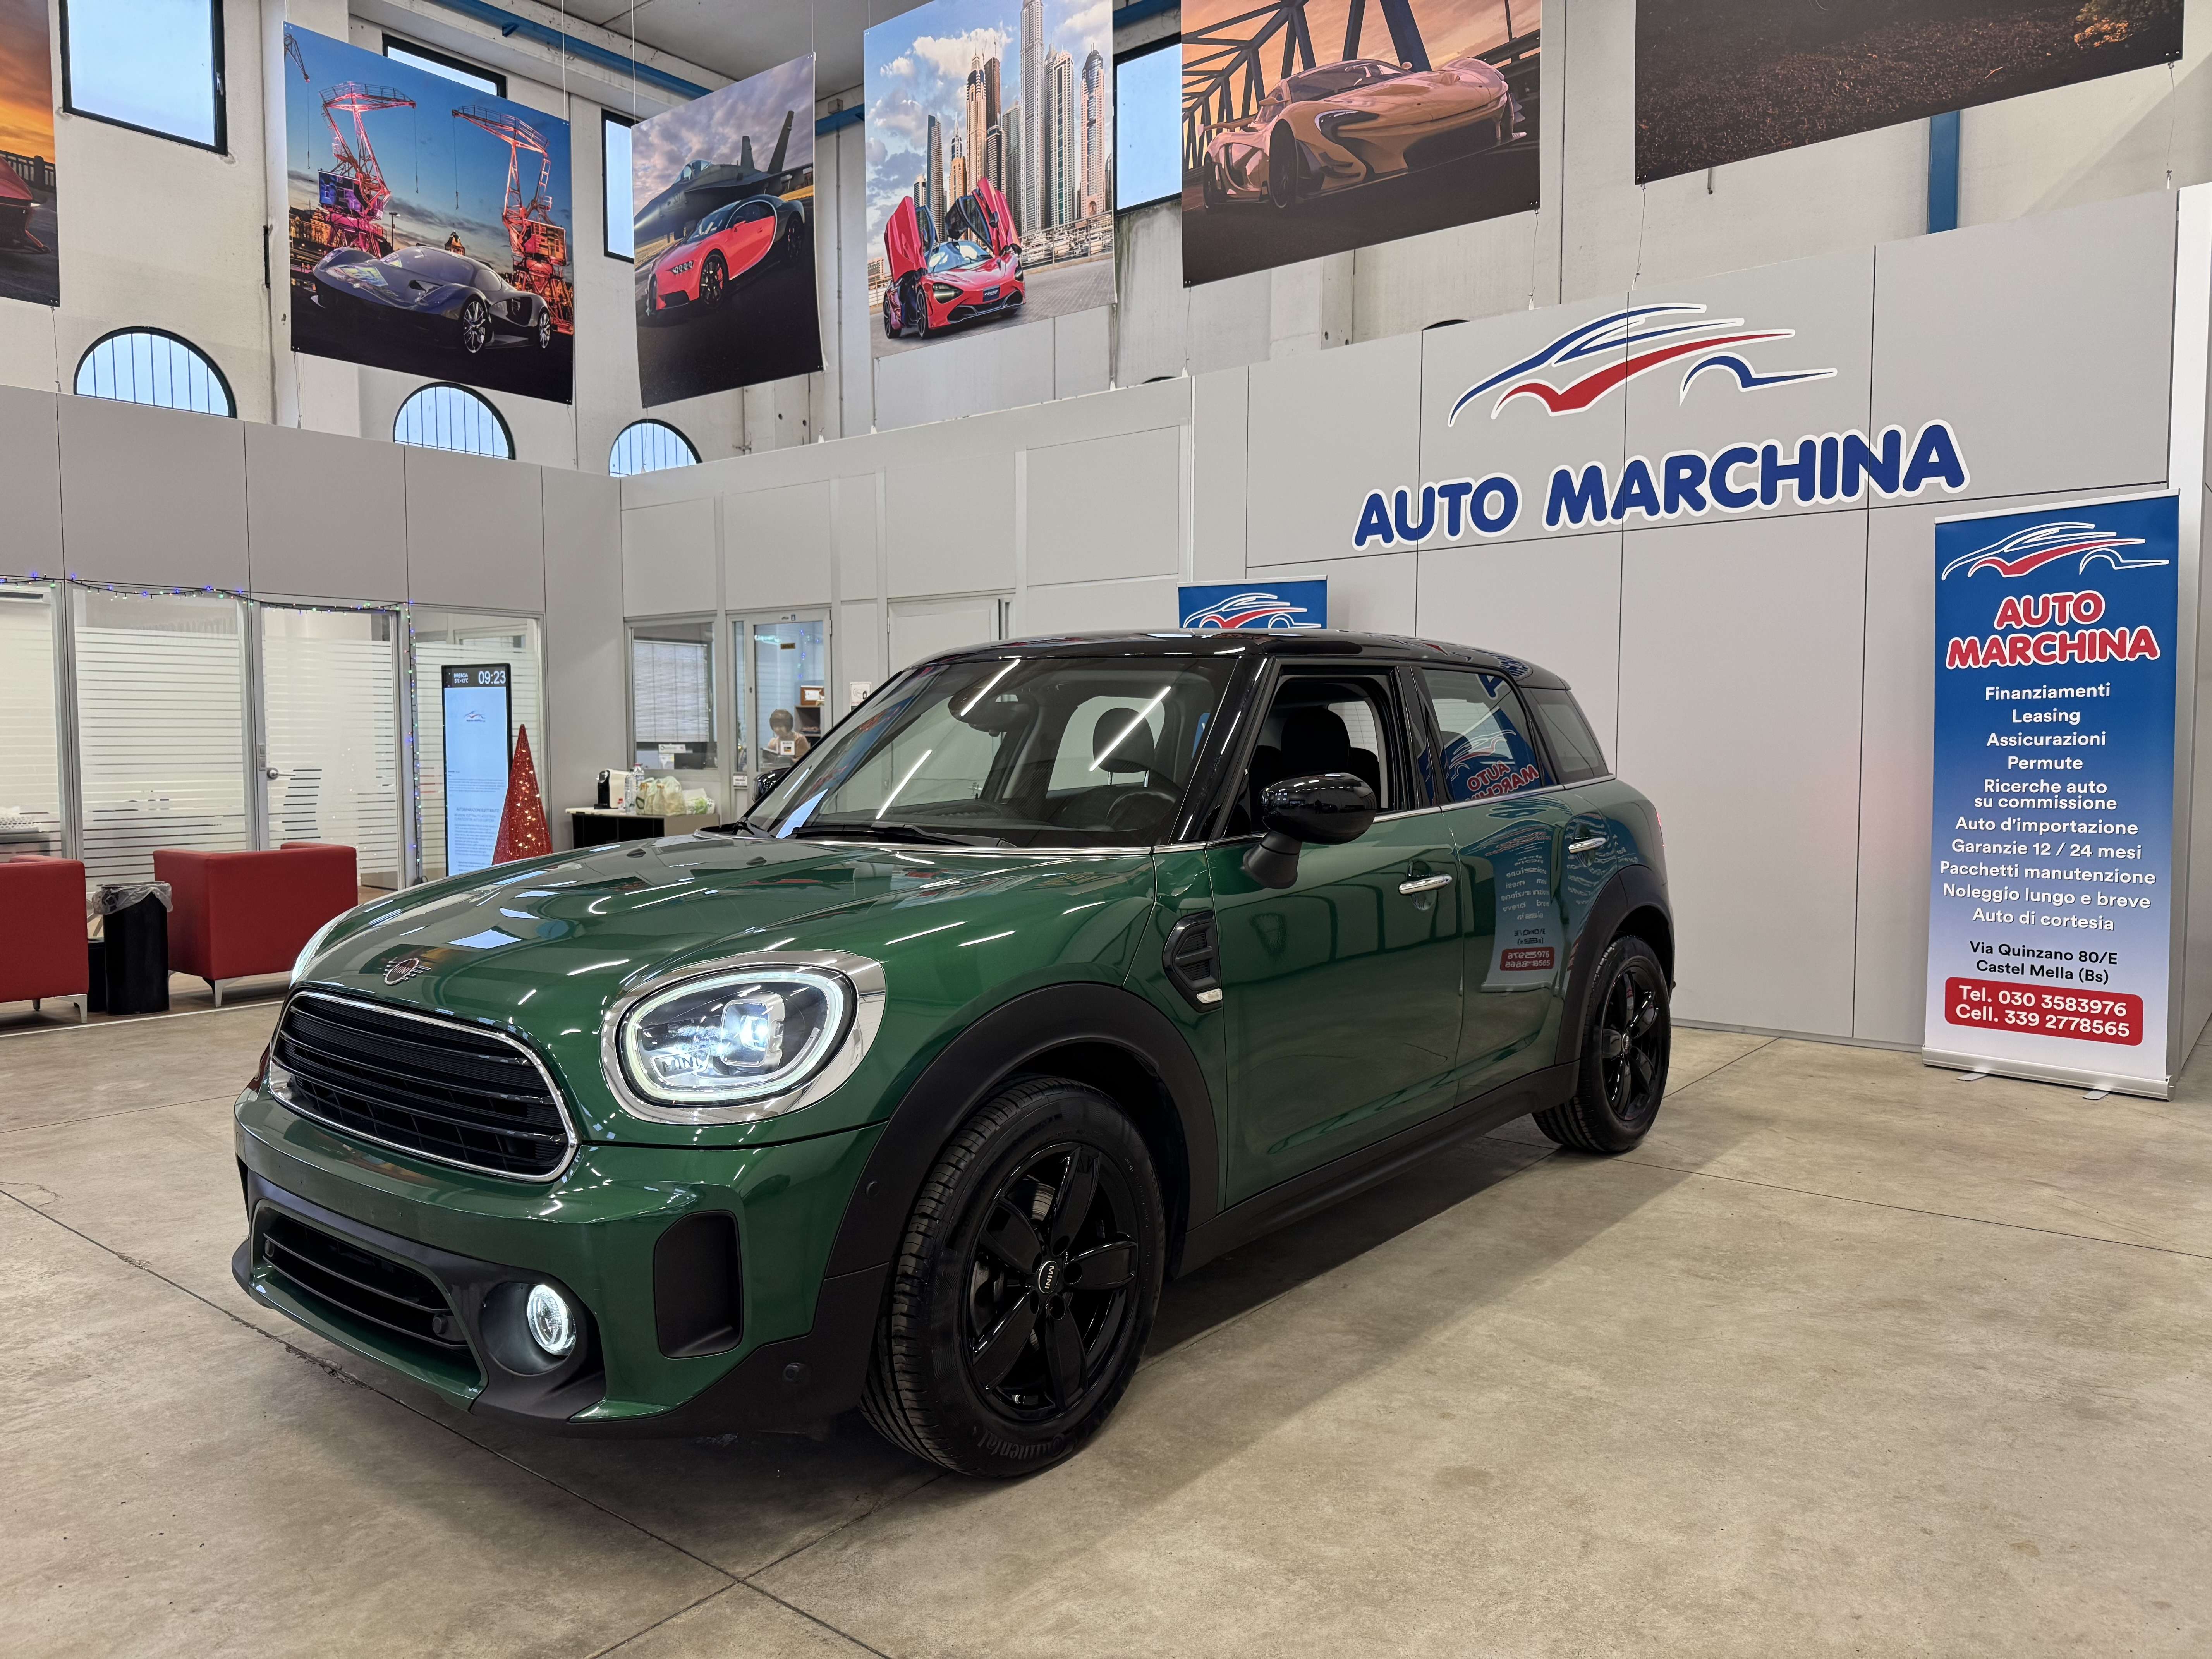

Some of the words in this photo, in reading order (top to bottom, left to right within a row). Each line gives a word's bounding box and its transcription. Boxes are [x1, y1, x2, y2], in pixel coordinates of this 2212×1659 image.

[1352, 471, 1523, 551] AUTO
[1542, 419, 1970, 531] MARCHINA
[1994, 590, 2105, 630] AUTO
[1946, 625, 2160, 670] MARCHINA
[478, 670, 506, 685] 09:23
[1986, 682, 2110, 700] Finanziamenti
[2013, 708, 2080, 725] Leasing
[1987, 731, 2106, 746] Assicurazioni
[2008, 756, 2083, 769] Permute
[1985, 779, 2061, 793] Ricerche
[2067, 781, 2107, 793] auto
[1975, 798, 1992, 807] su
[1999, 795, 2116, 809] commissione
[1956, 817, 1995, 830] Auto
[2001, 817, 2138, 835] d'importazione
[1952, 839, 2027, 854] Garanzie
[2033, 843, 2050, 855] 12
[2056, 843, 2065, 856] /
[2070, 844, 2092, 857] 24
[2099, 845, 2141, 859] mesi
[1941, 861, 2018, 877] Pacchetti
[2025, 868, 2155, 884] manutenzione
[1944, 883, 2019, 902] Noleggio
[2026, 888, 2075, 906] lungo
[2081, 895, 2091, 904] e
[2098, 892, 2150, 908] breve
[1972, 908, 2013, 922] Auto
[2019, 911, 2035, 924] di
[2041, 915, 2113, 930] cortesia
[1970, 941, 1993, 954] Via
[1999, 944, 2073, 960] Quinzano
[2079, 951, 2117, 964] 80/E
[392, 966, 412, 975] MINI
[1977, 960, 2024, 975] Castel
[2030, 964, 2073, 979] Mella
[2079, 968, 2108, 985] (Bs)
[1959, 985, 1992, 1002] Tel.
[1999, 991, 2035, 1006] 030
[2041, 995, 2126, 1016] 3583976
[1956, 1004, 1998, 1022] Cell.
[2005, 1010, 2039, 1026] 339
[2046, 1015, 2129, 1037] 2778565
[661, 1054, 699, 1072] MINI
[1044, 1265, 1055, 1289] MINI
